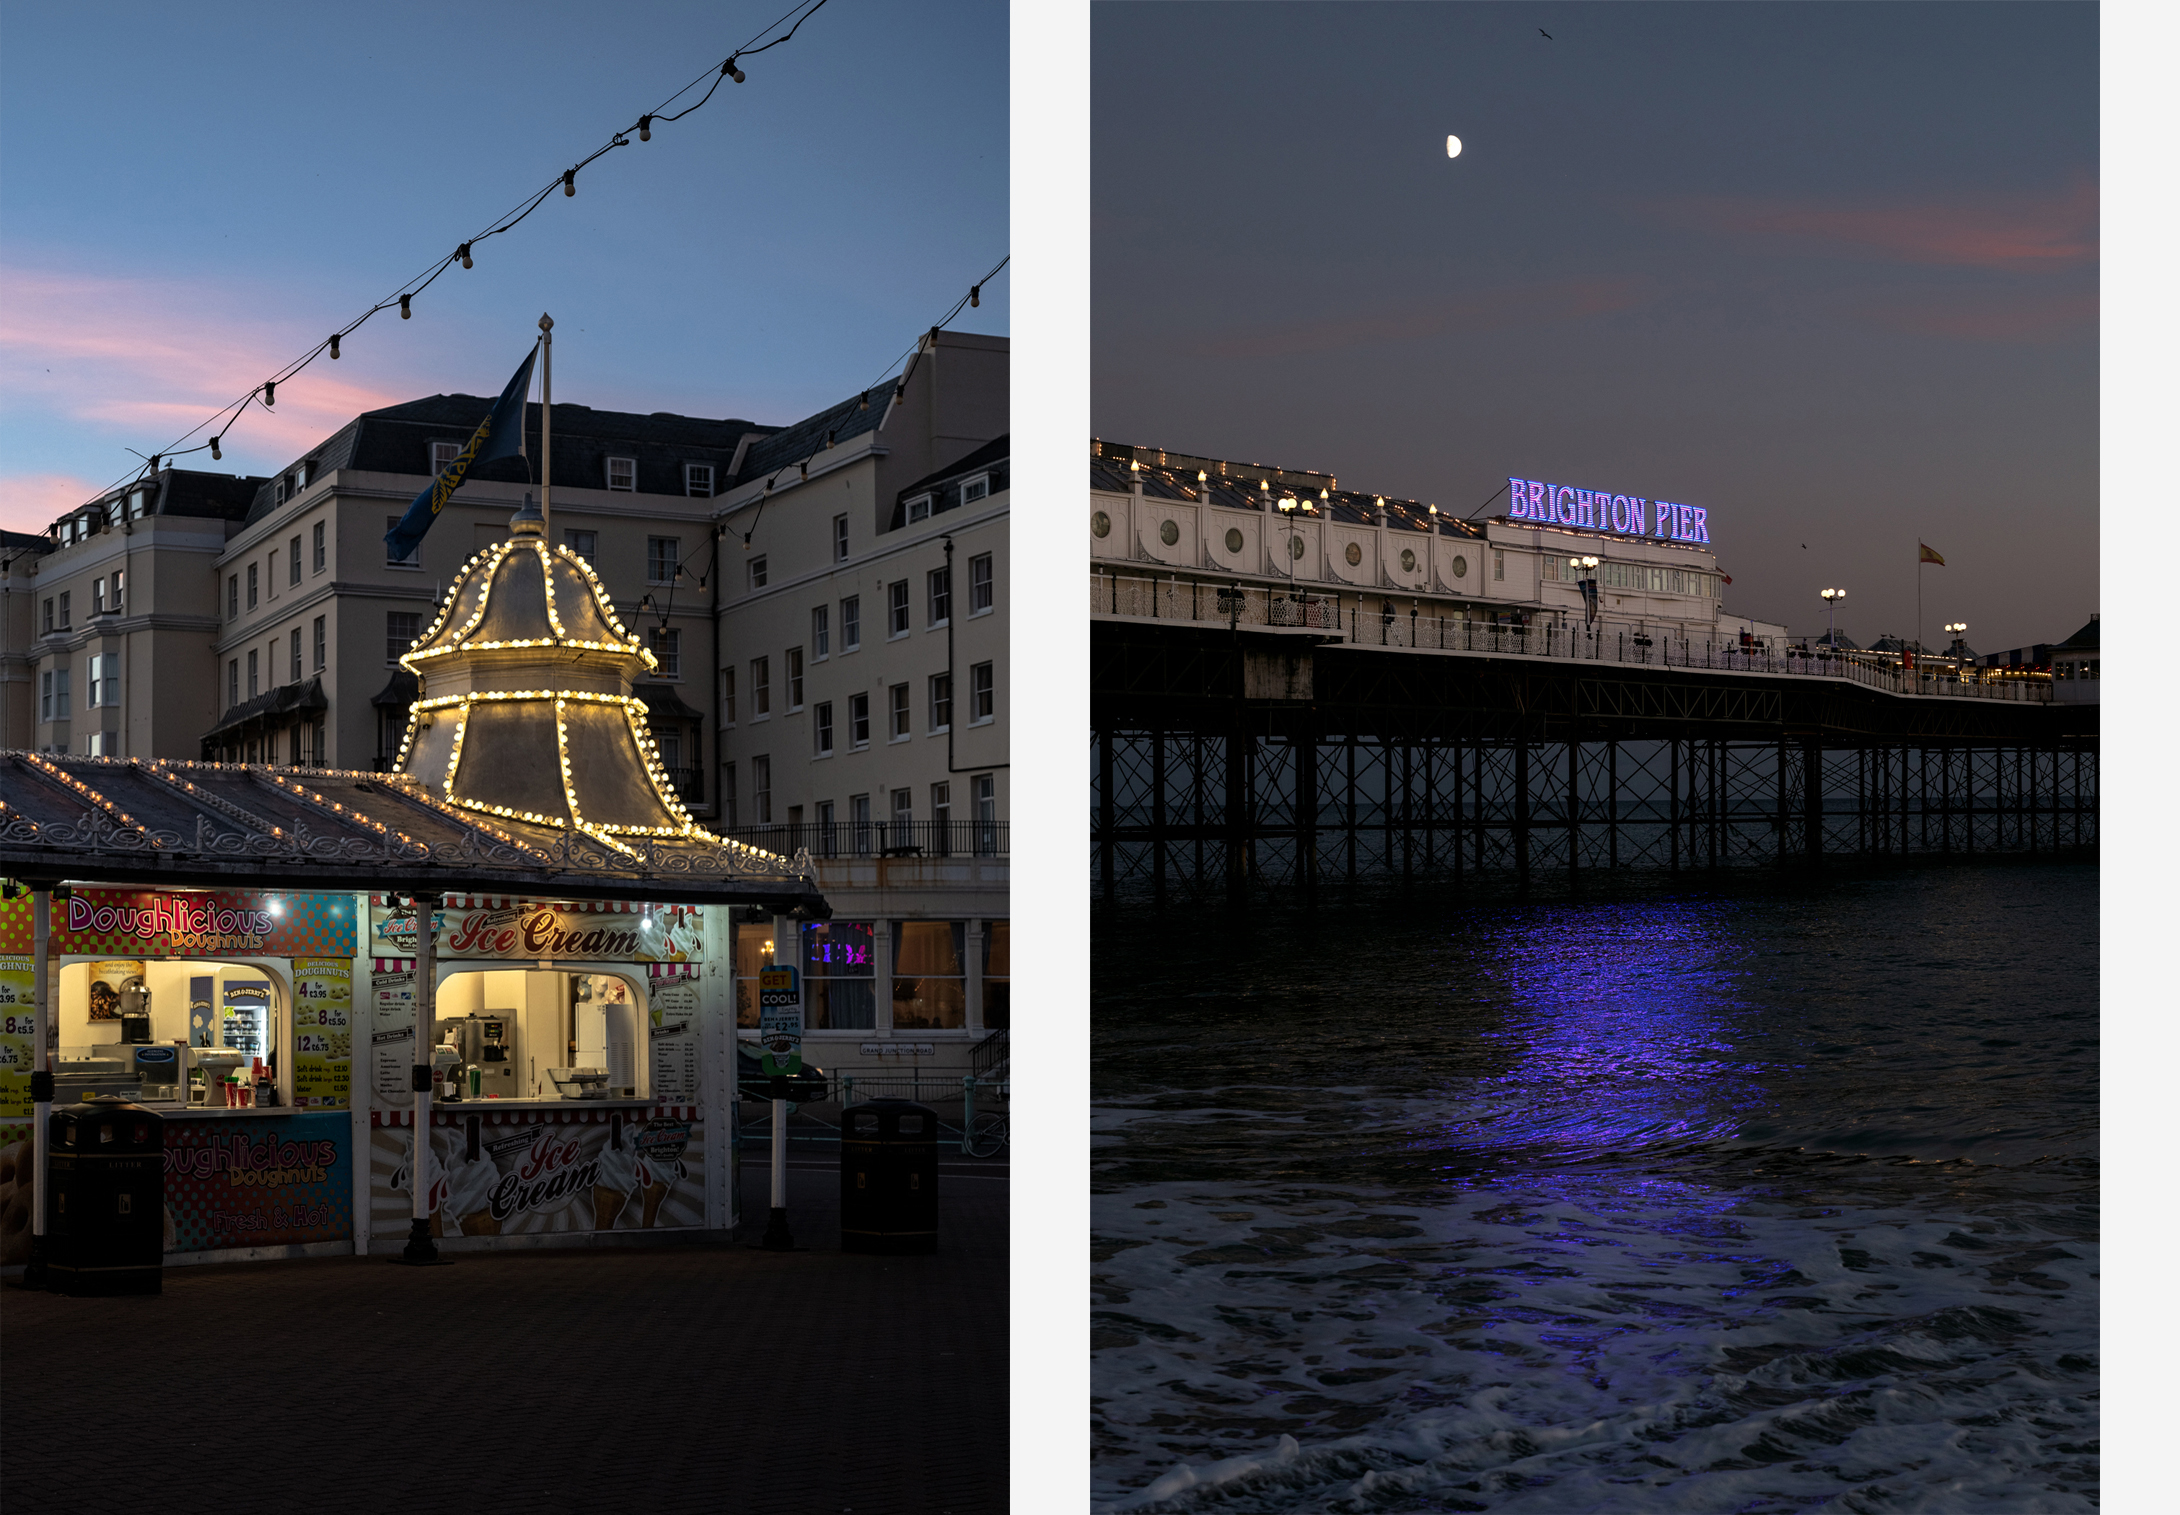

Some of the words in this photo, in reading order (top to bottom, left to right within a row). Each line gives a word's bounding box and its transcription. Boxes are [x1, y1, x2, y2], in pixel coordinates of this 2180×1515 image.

[1508, 477, 1647, 536] BRIGHTON
[1654, 500, 1710, 543] PIER
[69, 896, 274, 940] Doughlicious
[486, 912, 517, 925] Refreshing
[383, 919, 403, 934] Ice
[404, 916, 438, 932] Crm
[449, 909, 517, 953] Ice
[519, 909, 640, 955] Cream
[171, 929, 264, 952] Doughnuts
[307, 960, 339, 968] DELICIOUS
[295, 967, 349, 979] DOUGHNUTS
[762, 974, 787, 986] GET
[1, 985, 11, 994] for
[230, 989, 241, 998] BEN
[245, 988, 264, 998] JERRY'S
[298, 982, 308, 998] 4
[309, 990, 327, 998] £3.95
[762, 994, 797, 1004] COOL!
[319, 1009, 328, 1025] 8
[334, 1009, 342, 1017] for
[328, 1018, 346, 1026] £5.50
[5, 1016, 16, 1034] 8
[25, 1016, 34, 1025] for
[17, 1026, 34, 1034] £5.5
[775, 1022, 799, 1031] £2.95
[297, 1035, 310, 1052] 12
[317, 1035, 325, 1043] for
[763, 1036, 774, 1044] BEN
[779, 1035, 800, 1044] JERRY'S
[4, 1046, 13, 1054] for
[311, 1043, 329, 1052] £6.75
[0, 1055, 18, 1064] 6.75
[297, 1064, 308, 1072] Soft
[309, 1064, 322, 1072] drink
[297, 1074, 308, 1082] Soft
[309, 1074, 322, 1082] drink
[639, 1131, 656, 1145] Ice
[657, 1128, 686, 1143] Cream
[492, 1135, 529, 1152] Refreshing
[520, 1132, 581, 1180] Ice
[650, 1146, 679, 1154] Brighton!
[230, 1162, 328, 1188] Doughnuts
[487, 1159, 601, 1220] Cream
[213, 1208, 268, 1233] Fresh
[273, 1206, 289, 1229] &
[293, 1203, 329, 1228] Hot
